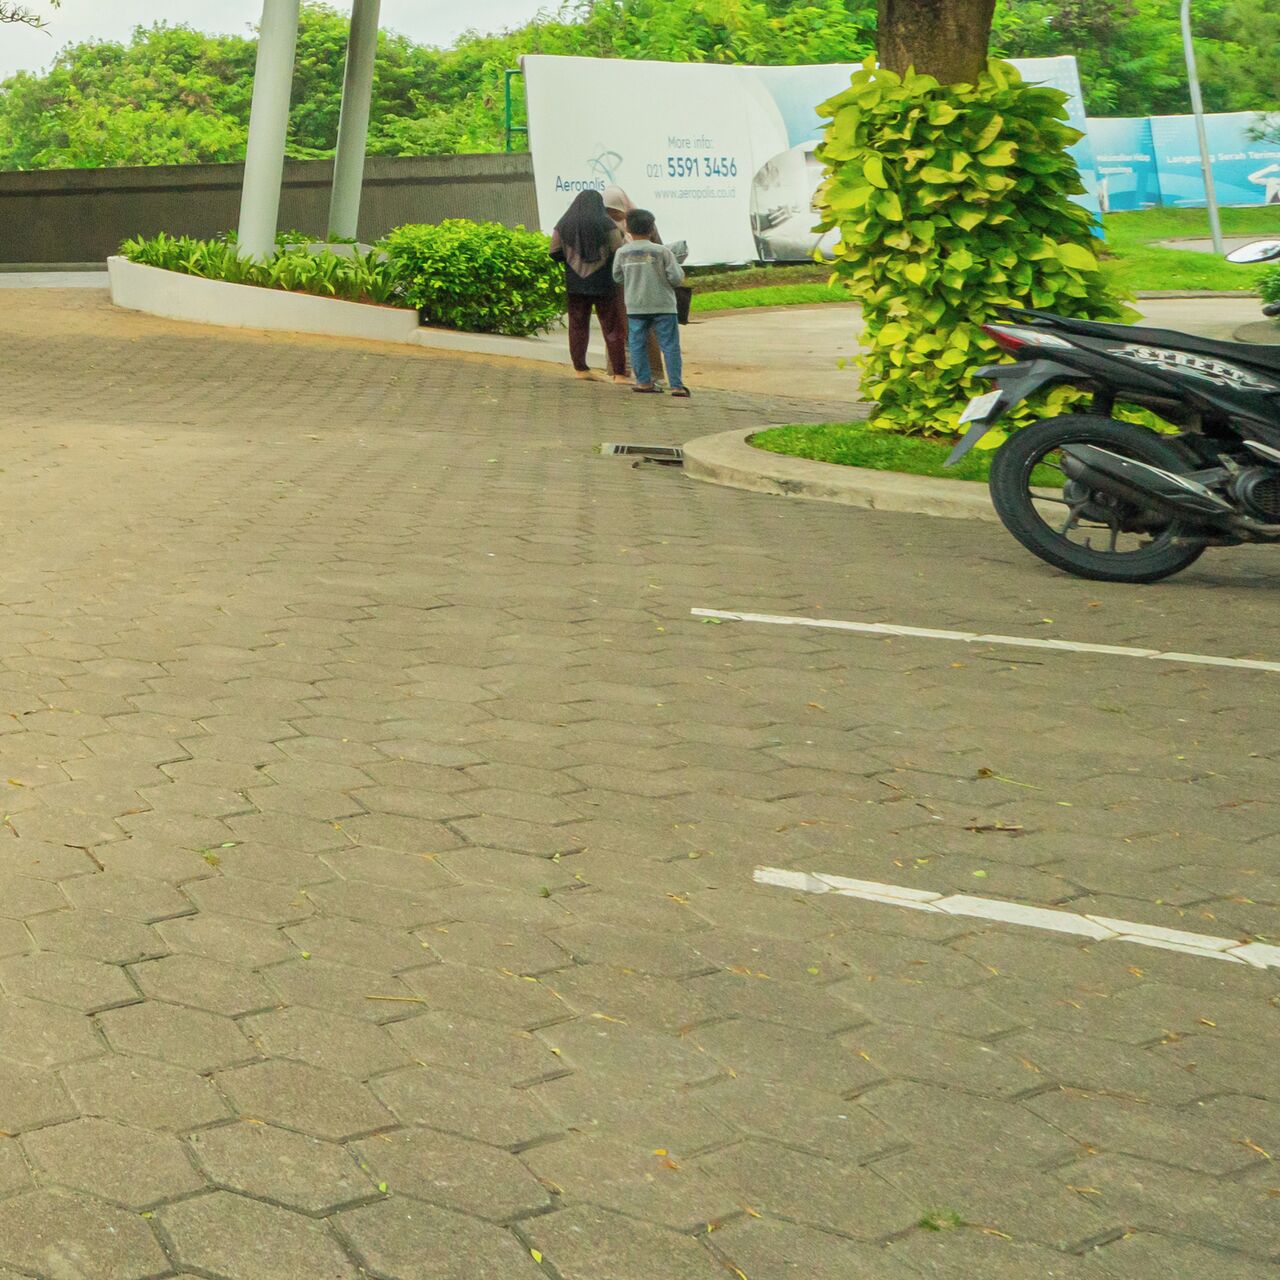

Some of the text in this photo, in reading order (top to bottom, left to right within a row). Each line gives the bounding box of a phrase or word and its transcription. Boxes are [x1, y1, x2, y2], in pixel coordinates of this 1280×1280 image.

[668, 134, 714, 149] More info:
[646, 156, 737, 178] 021 5591 3456
